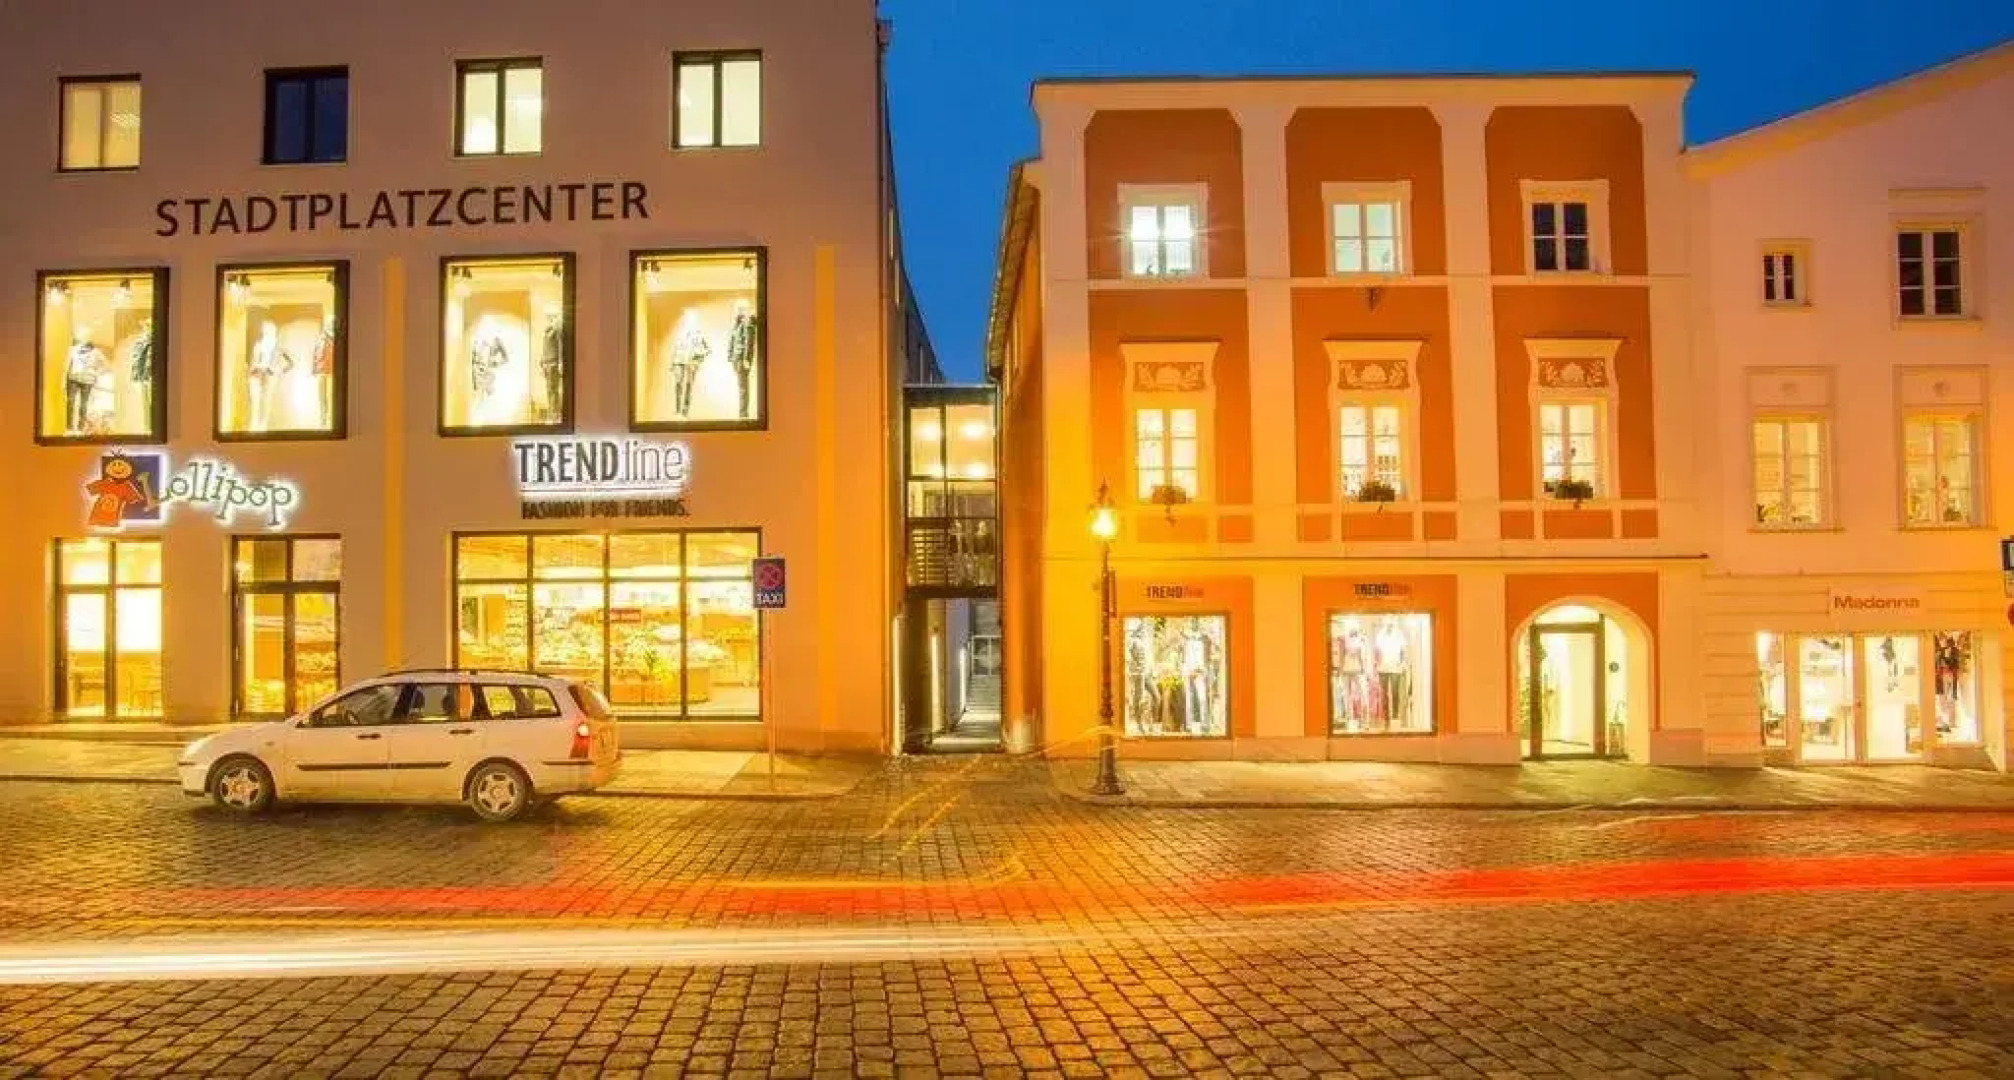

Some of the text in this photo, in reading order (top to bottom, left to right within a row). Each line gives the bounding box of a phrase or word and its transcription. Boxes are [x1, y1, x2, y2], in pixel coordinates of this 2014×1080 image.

[155, 181, 649, 237] STADTPLATZCENTER
[137, 461, 292, 526] Lollipop
[522, 501, 585, 519] FASHION
[591, 500, 619, 518] FOR
[756, 593, 784, 605] TAXI
[1834, 596, 1920, 609] Madonna
